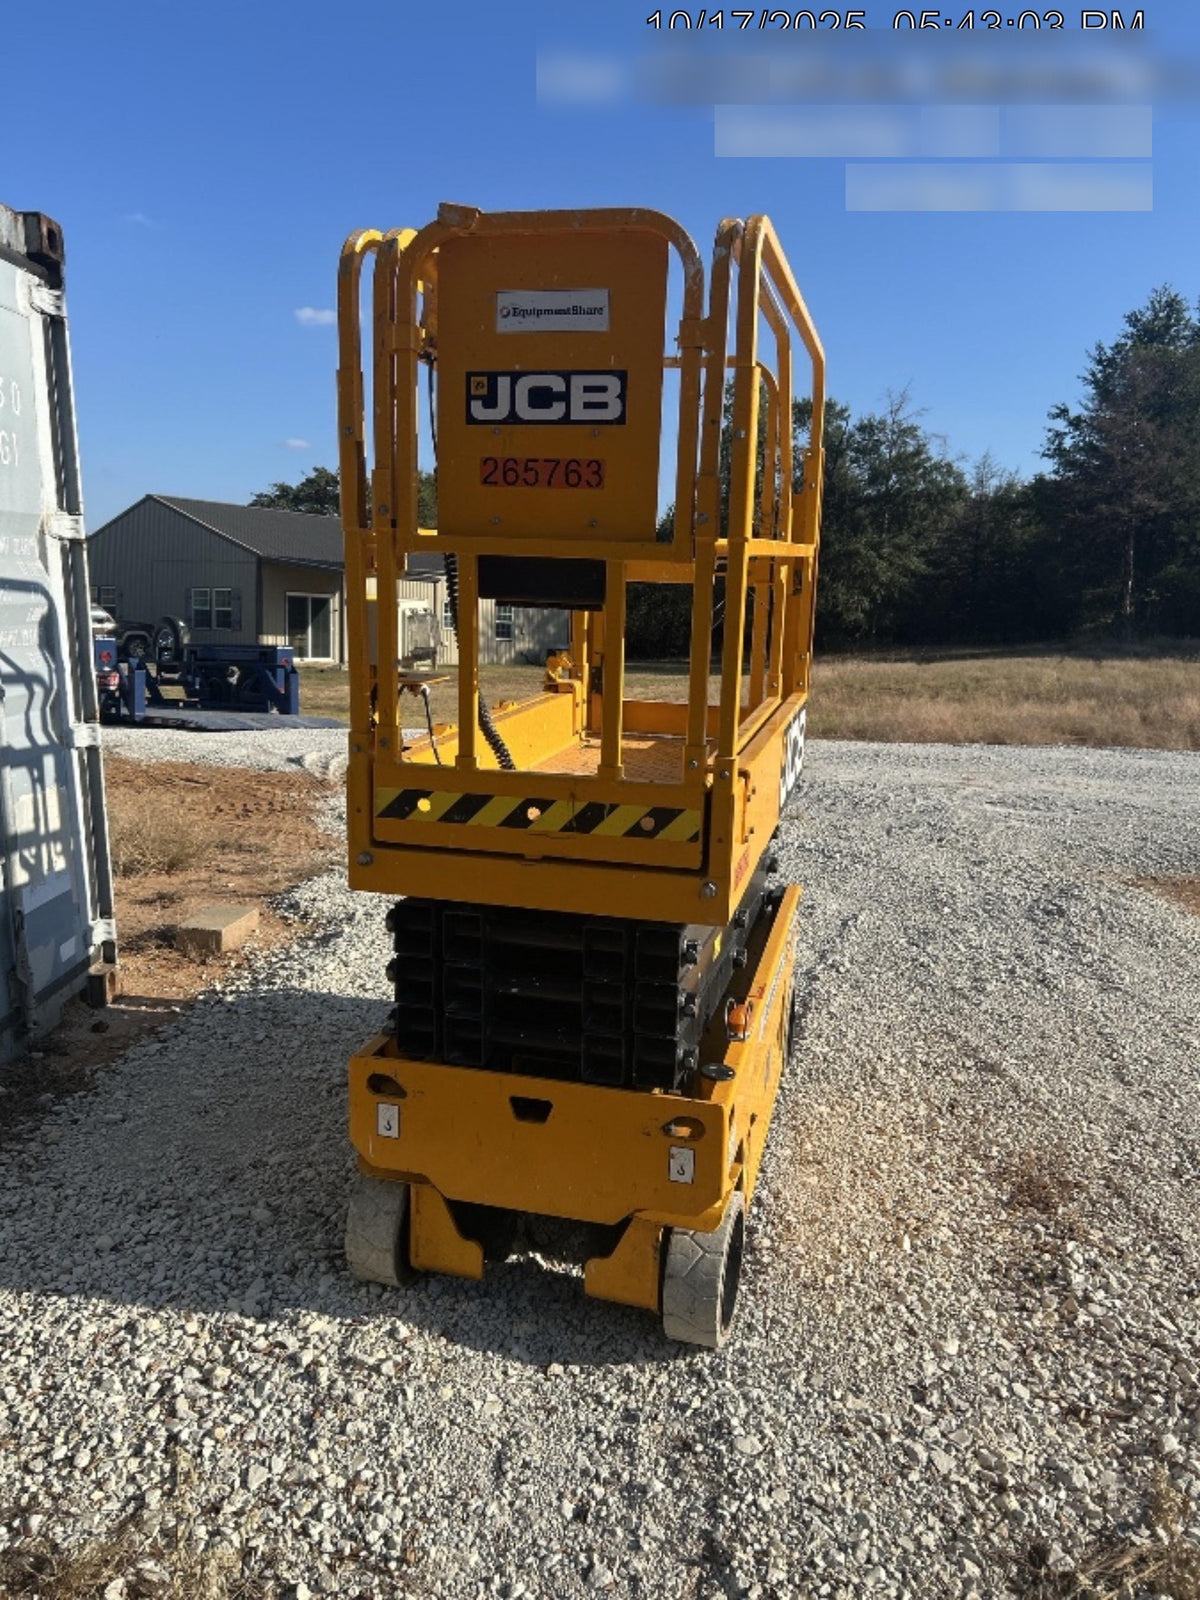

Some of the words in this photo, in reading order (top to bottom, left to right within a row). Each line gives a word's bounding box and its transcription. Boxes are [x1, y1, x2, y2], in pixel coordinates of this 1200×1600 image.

[511, 305, 604, 318] EquipmentShare
[470, 374, 624, 421] JCB
[482, 456, 604, 489] 265763
